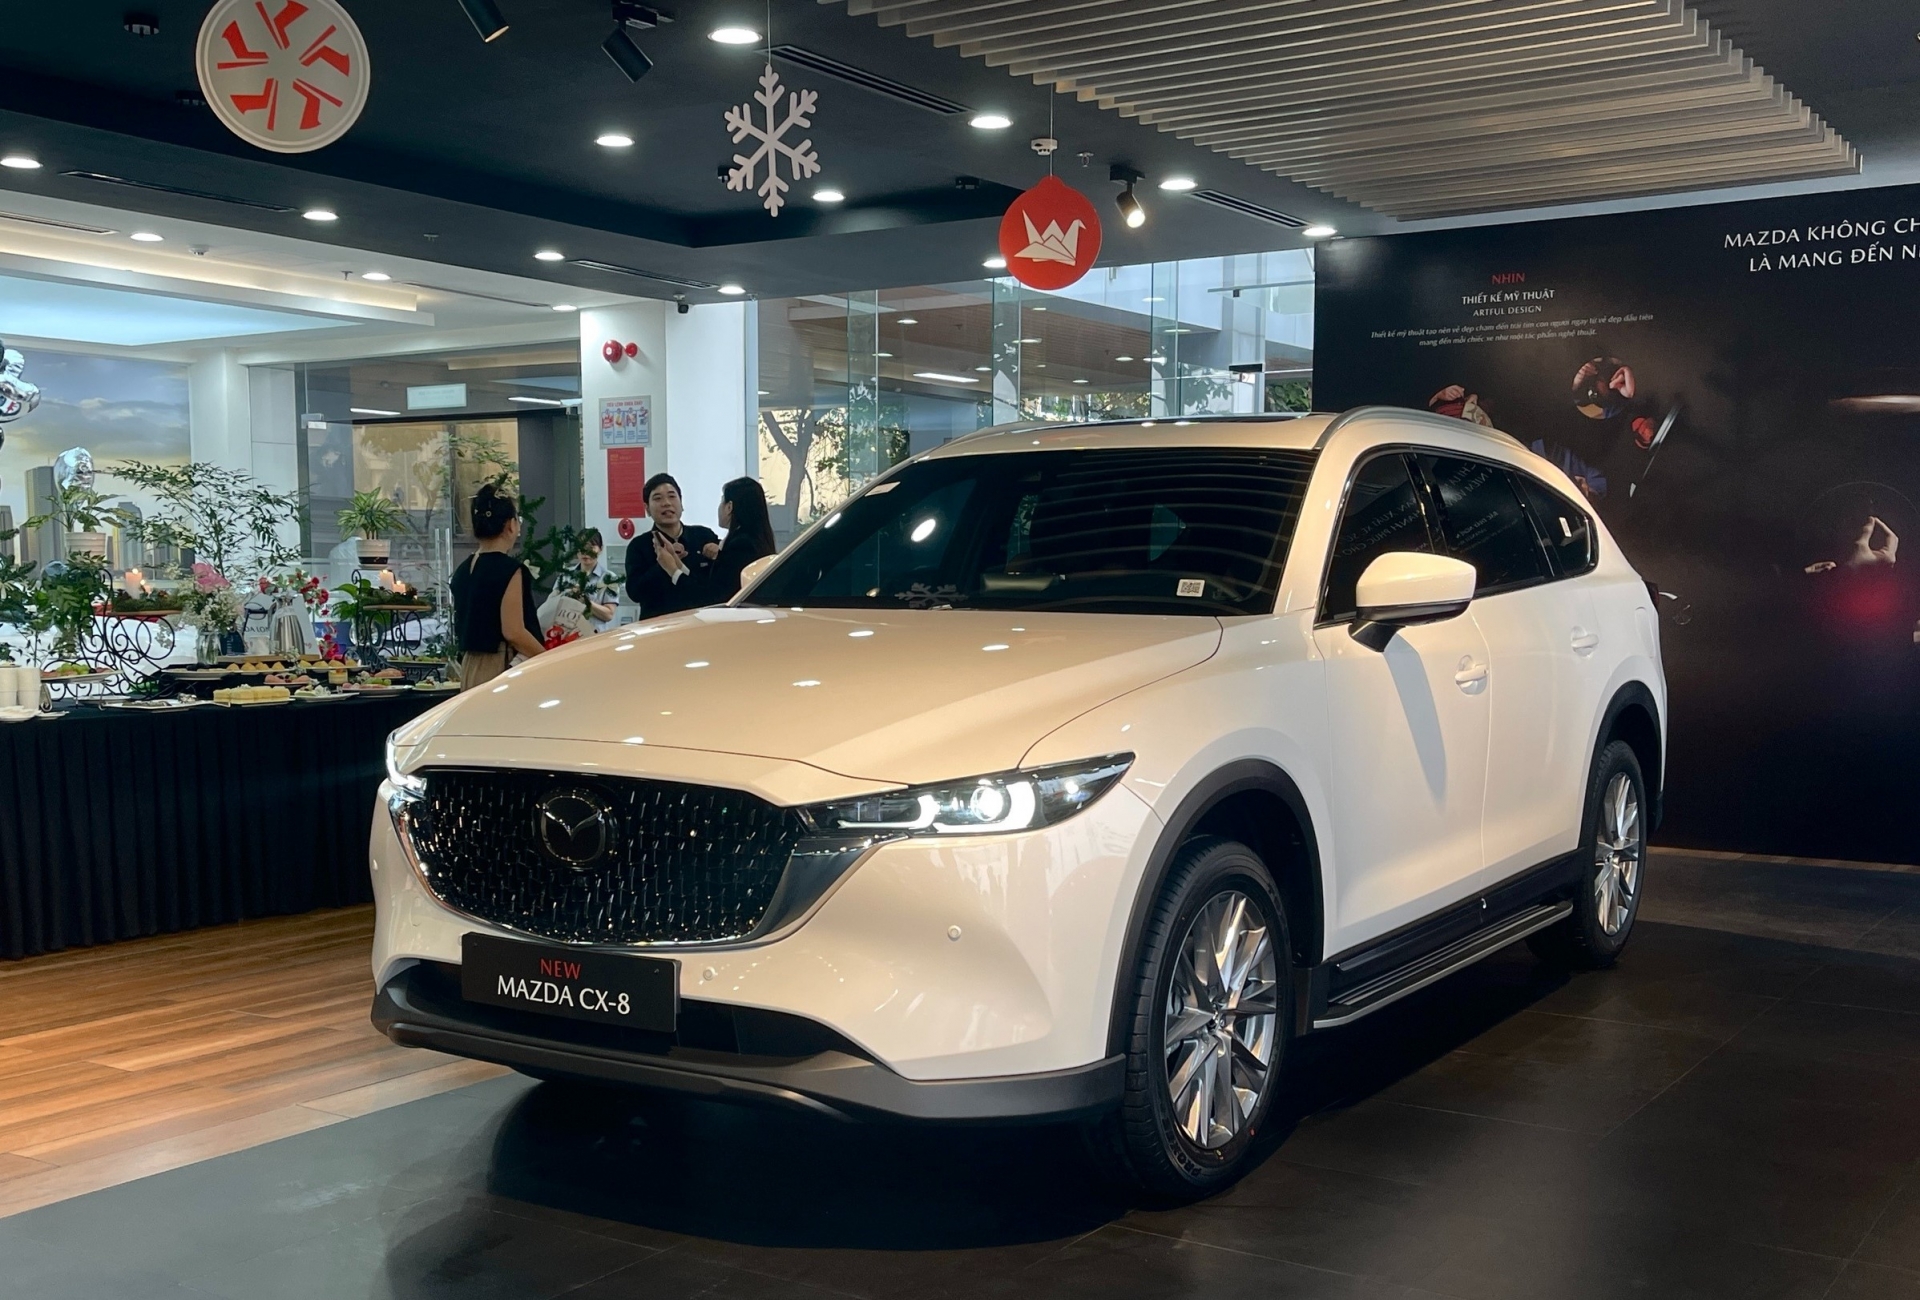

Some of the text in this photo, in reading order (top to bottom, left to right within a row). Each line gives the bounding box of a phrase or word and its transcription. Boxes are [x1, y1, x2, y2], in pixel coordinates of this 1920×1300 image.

[1723, 228, 1800, 249] MAZDA
[1807, 219, 1886, 241] KHÔNG
[1749, 252, 1772, 272] LÀ
[1778, 250, 1843, 270] MANG
[1850, 241, 1893, 264] ĐẾN
[1461, 288, 1556, 305] THIẾT KẾ MỸ THUẬT
[1472, 305, 1542, 317] ARTFUL DESIGN
[540, 958, 582, 980] NEW
[497, 974, 631, 1015] MAZDA CX-8
